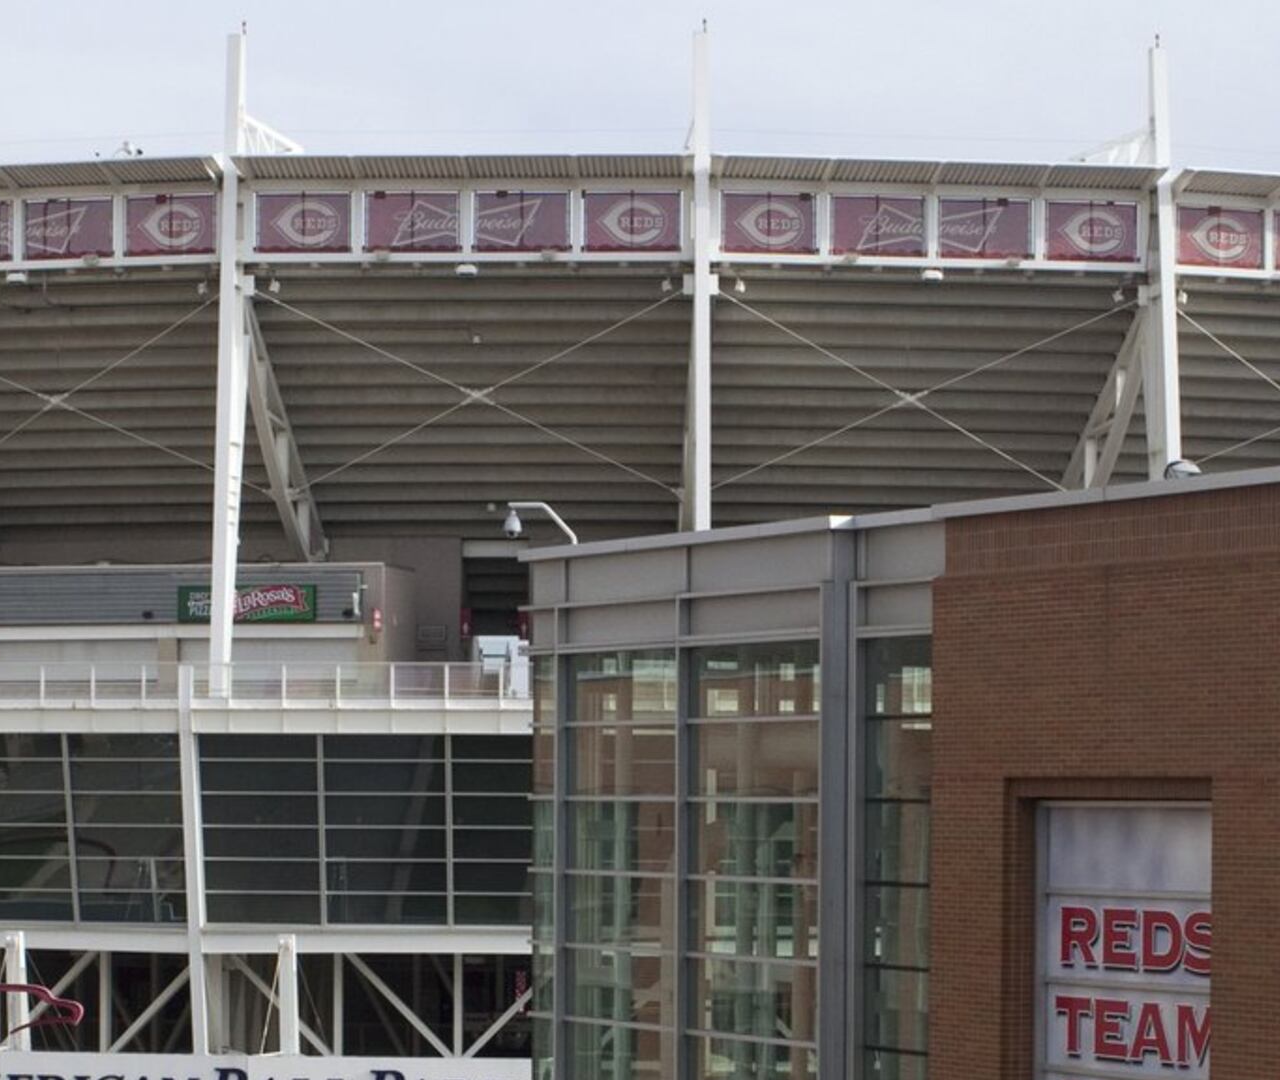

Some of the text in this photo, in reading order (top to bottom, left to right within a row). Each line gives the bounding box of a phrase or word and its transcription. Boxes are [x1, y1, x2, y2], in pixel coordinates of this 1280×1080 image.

[159, 219, 201, 233] REDS
[293, 217, 338, 231] REDS
[619, 216, 664, 230] REDS
[758, 217, 800, 231] REDS
[1079, 224, 1121, 239] REDS
[1209, 232, 1247, 246] REDS
[1060, 906, 1212, 974] REDS
[1055, 995, 1211, 1066] TEAM
